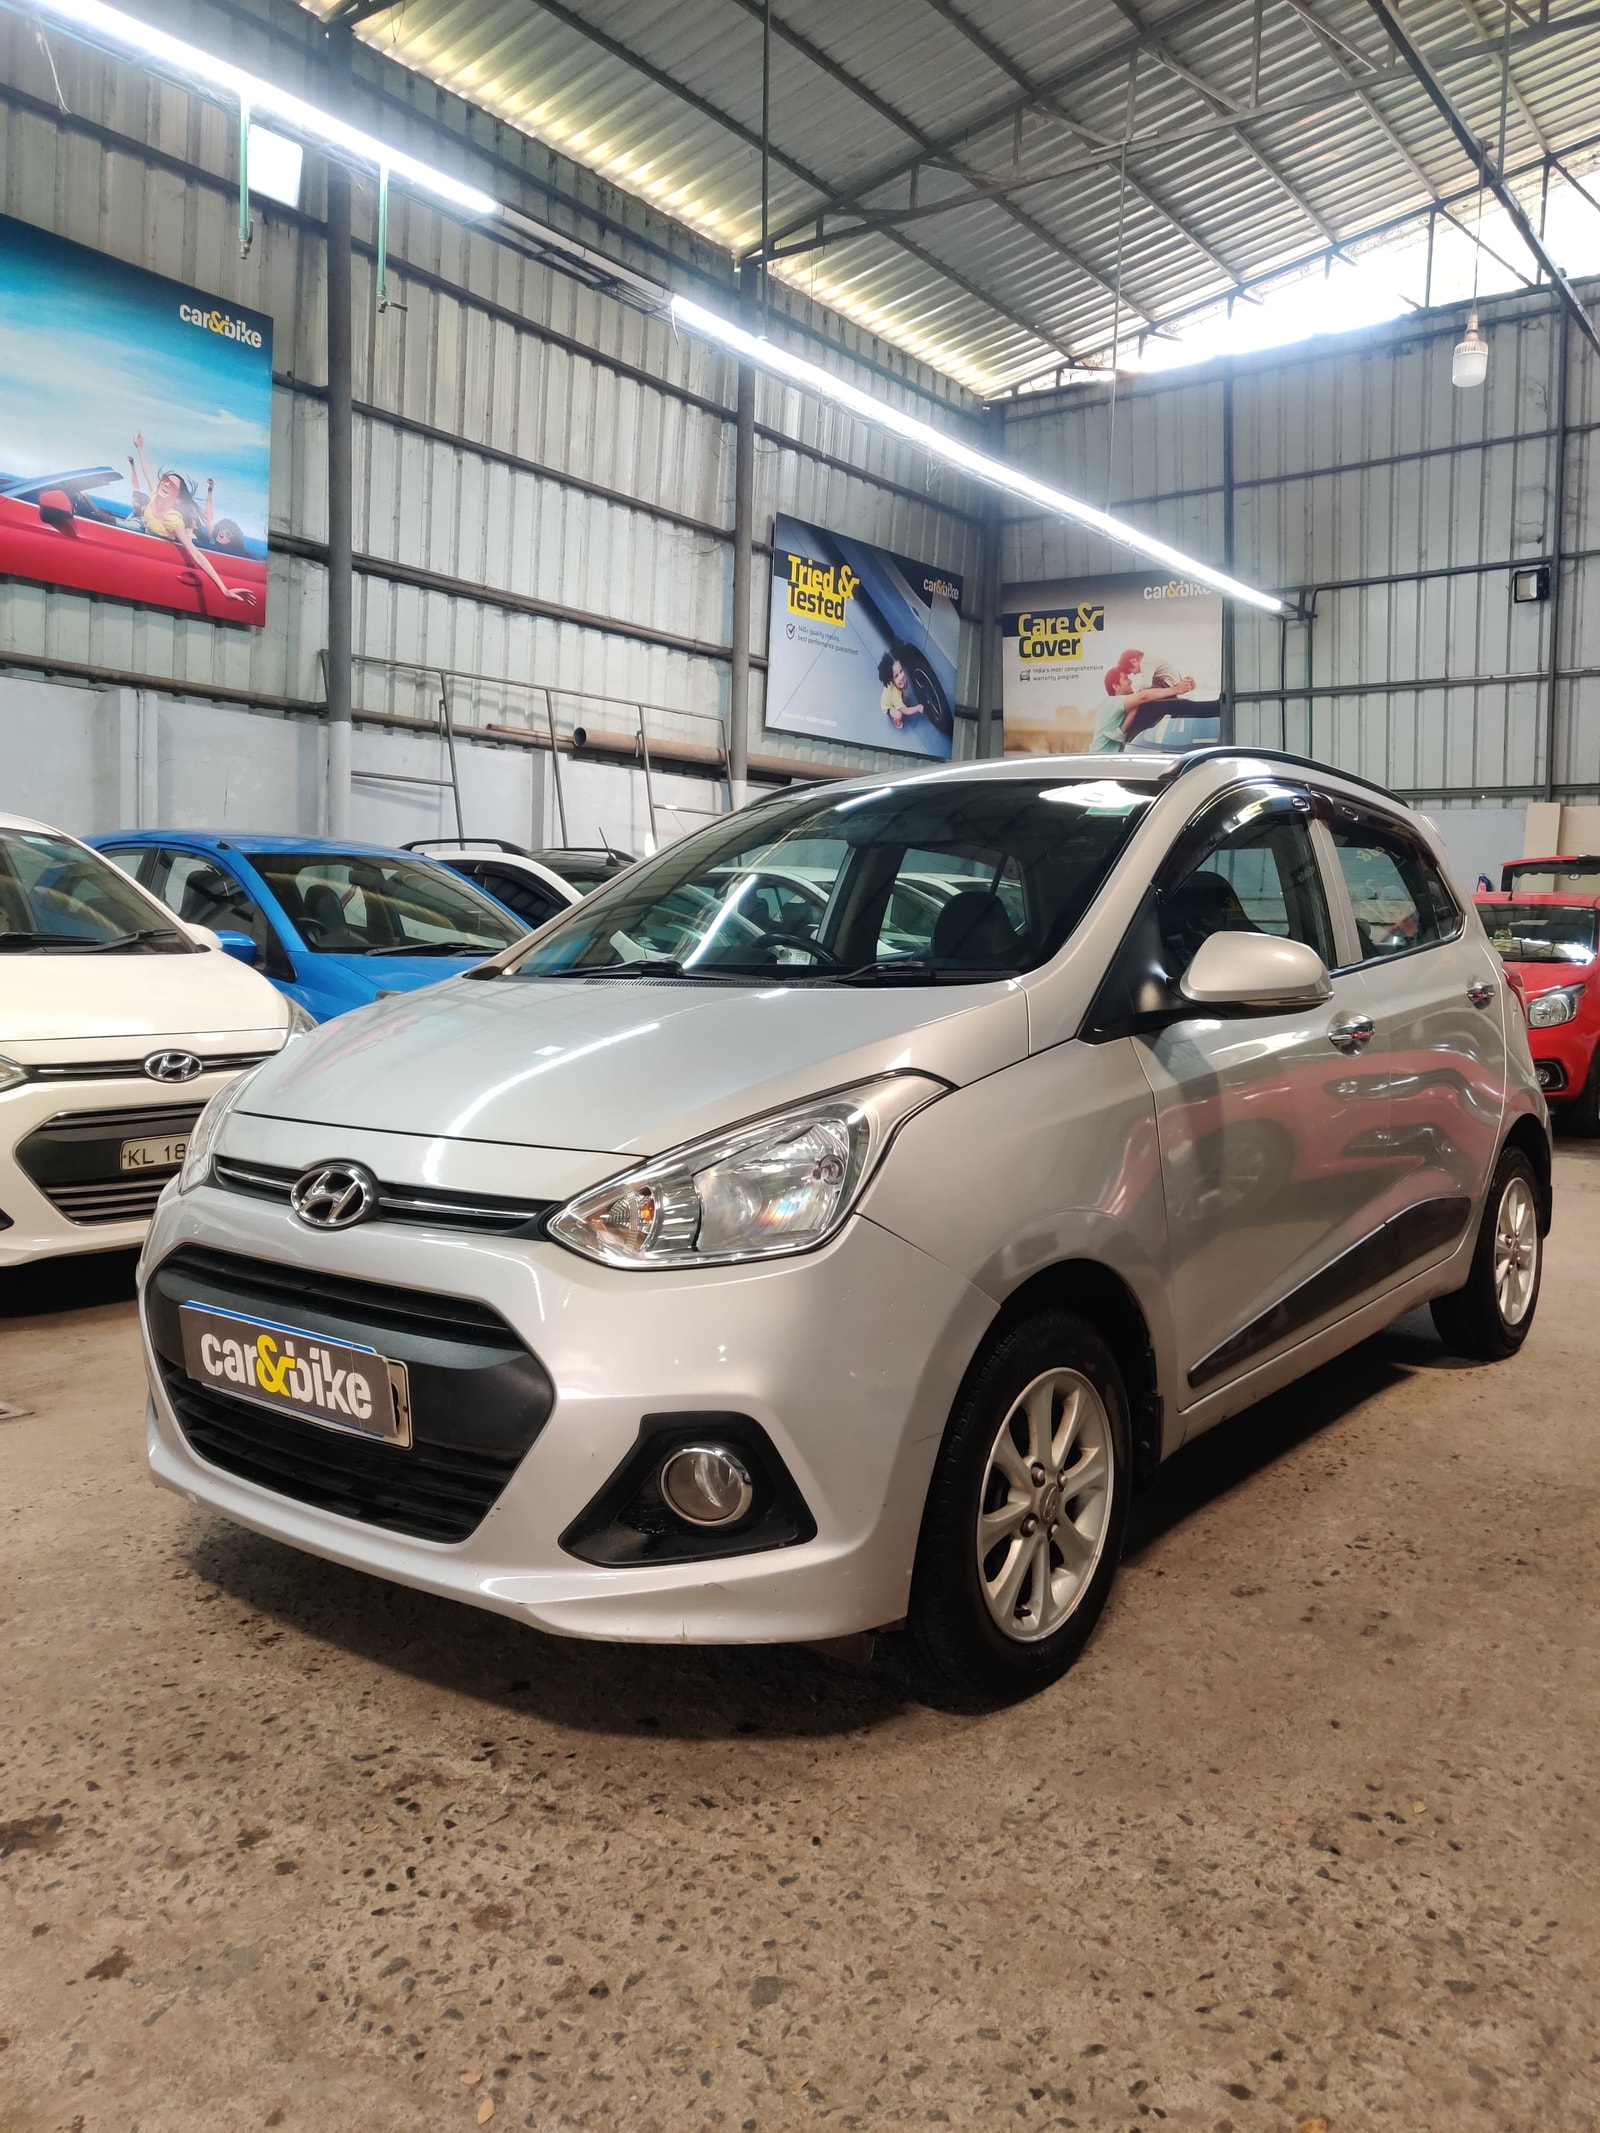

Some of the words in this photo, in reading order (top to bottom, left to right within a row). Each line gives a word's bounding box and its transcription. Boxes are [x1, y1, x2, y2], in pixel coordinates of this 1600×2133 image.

[179, 304, 262, 348] car&bike
[788, 554, 834, 594] Tried
[838, 565, 860, 600] &
[923, 578, 959, 600] car&bike
[788, 581, 845, 621] Tested
[1018, 613, 1070, 637] Care
[1075, 602, 1104, 632] &
[1018, 635, 1081, 658] Cover
[128, 1148, 154, 1167] KL
[164, 1143, 186, 1161] 18
[200, 1333, 373, 1420] car&bike
